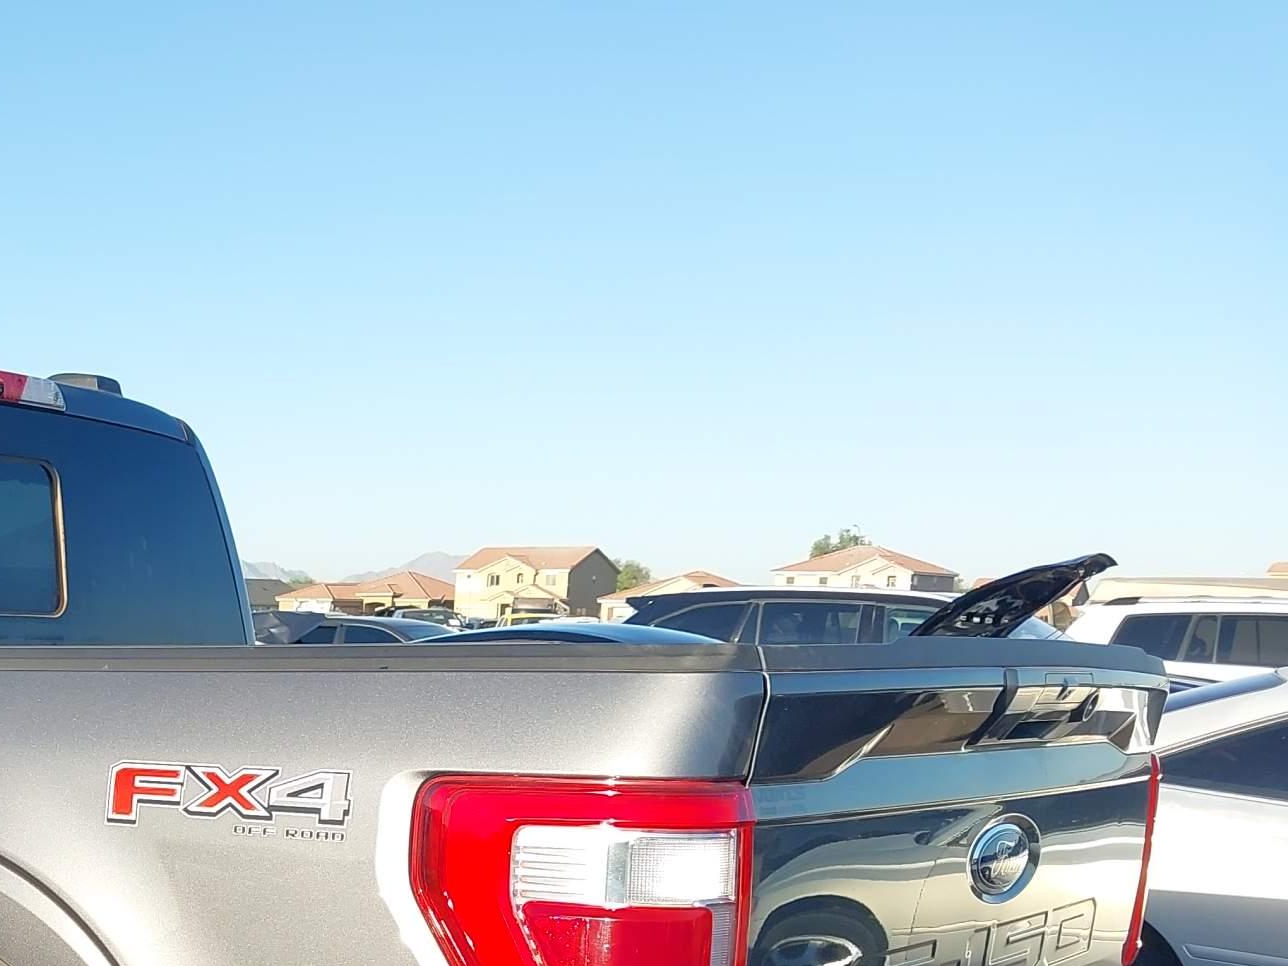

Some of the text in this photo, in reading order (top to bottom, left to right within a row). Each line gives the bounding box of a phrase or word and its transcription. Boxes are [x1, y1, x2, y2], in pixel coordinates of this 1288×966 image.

[105, 761, 353, 826] FX4
[233, 824, 345, 842] OFF ROAD
